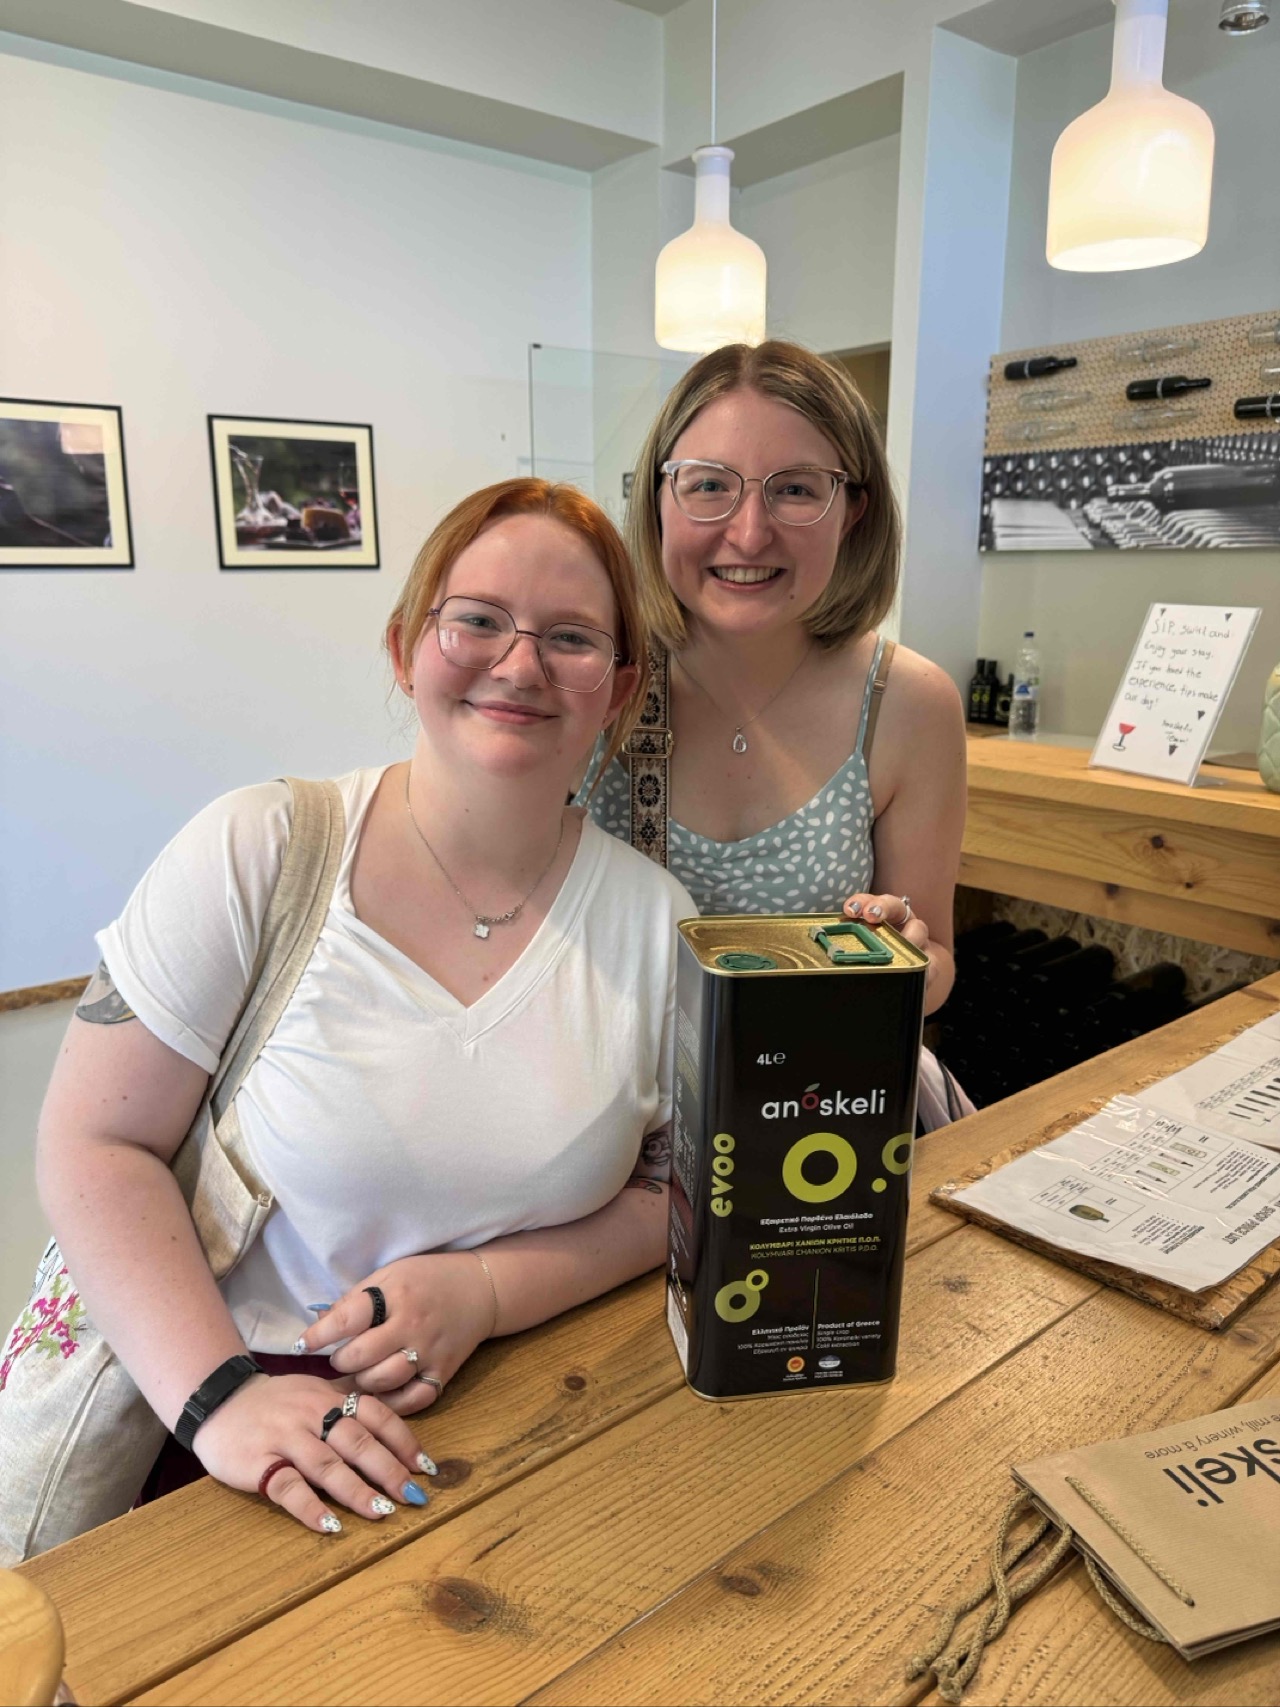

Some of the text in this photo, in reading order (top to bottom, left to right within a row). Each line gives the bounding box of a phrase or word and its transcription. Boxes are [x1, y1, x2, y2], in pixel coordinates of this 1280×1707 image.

[1208, 630, 1230, 638] and
[1169, 649, 1187, 659] your
[1134, 660, 1148, 670] If
[1186, 667, 1202, 678] the
[1180, 684, 1196, 697] tips
[1197, 690, 1219, 702] make
[710, 1133, 736, 1217] evoo
[800, 1224, 822, 1233] Virgin
[823, 1223, 842, 1231] Olive
[843, 1222, 855, 1230] Oil
[856, 1320, 880, 1328] Greece
[1195, 1425, 1244, 1447] winery
[1144, 1444, 1183, 1459] more
